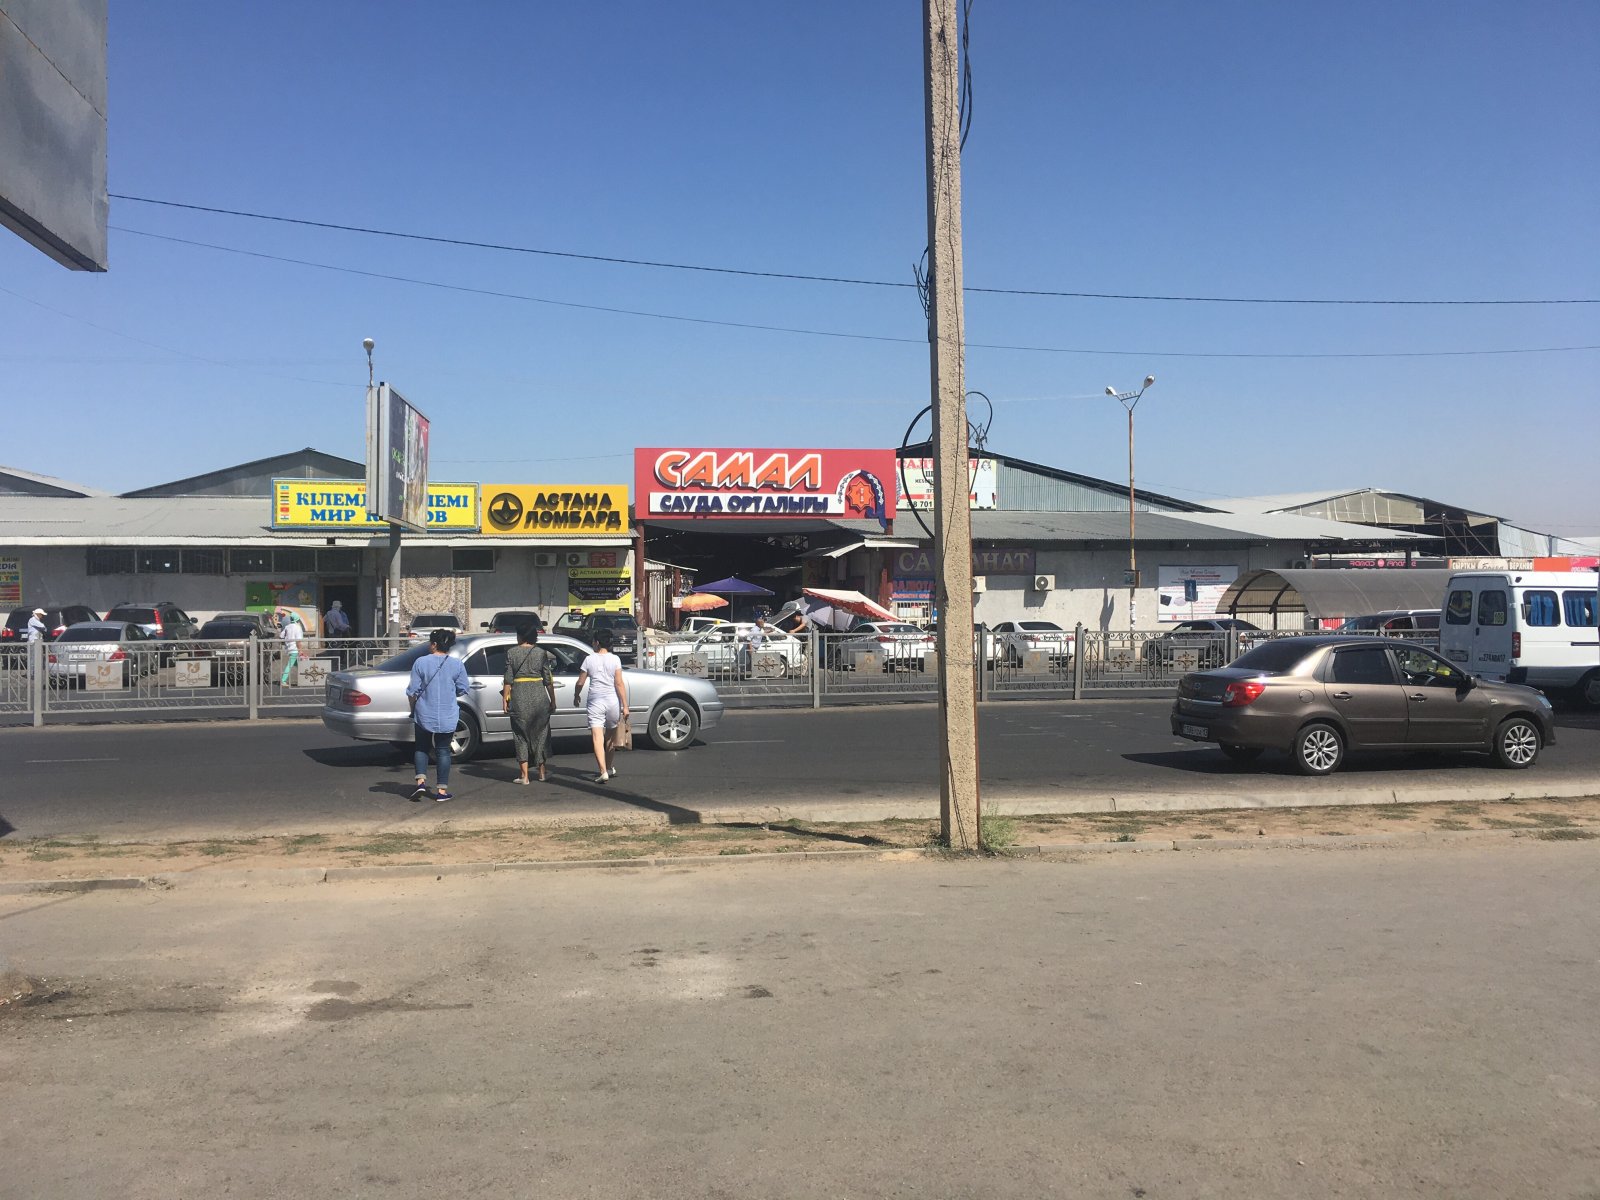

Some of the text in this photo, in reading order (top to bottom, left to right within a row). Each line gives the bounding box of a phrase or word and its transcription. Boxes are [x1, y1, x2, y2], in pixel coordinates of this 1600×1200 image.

[654, 451, 822, 489] САМАЛ
[533, 493, 612, 509] АСТАНА
[660, 495, 723, 512] САУДА
[310, 509, 356, 521] МИР
[524, 511, 621, 529] ЛОМБАРД
